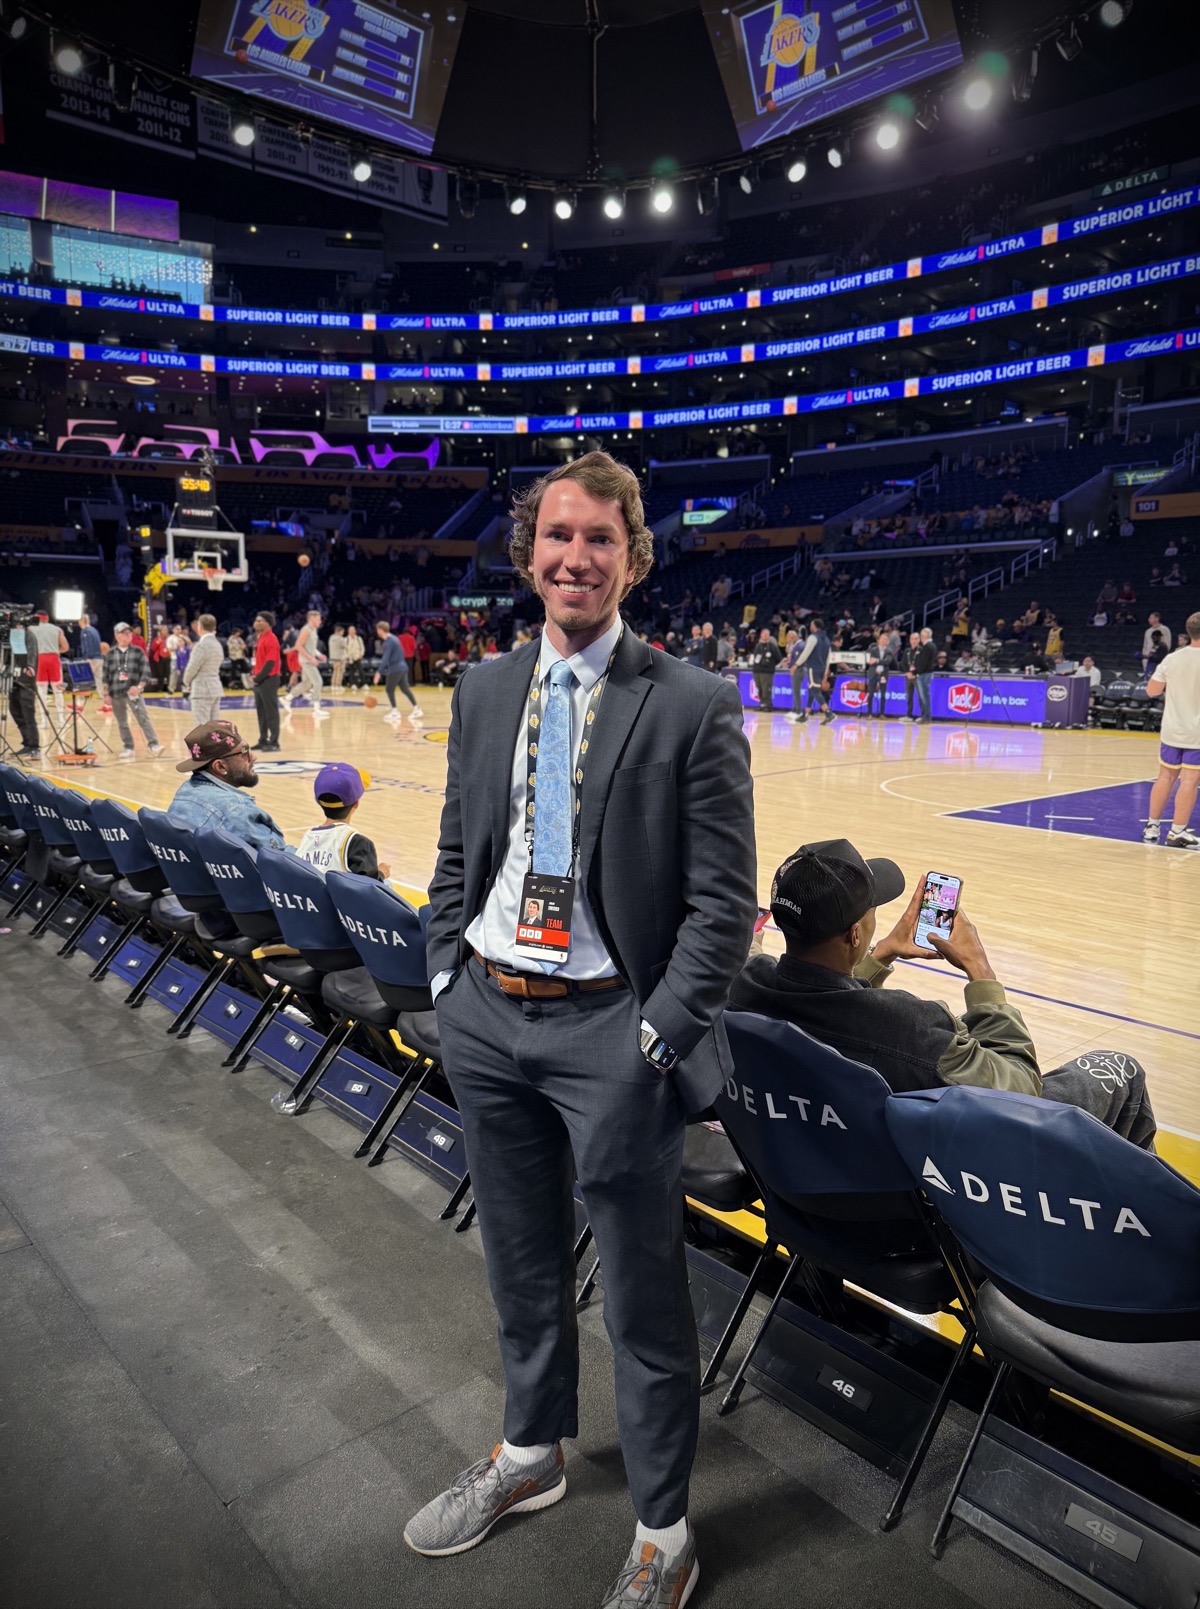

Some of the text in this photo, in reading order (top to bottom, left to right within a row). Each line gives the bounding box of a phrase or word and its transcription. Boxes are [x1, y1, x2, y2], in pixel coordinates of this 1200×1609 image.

[767, 25, 813, 59] LAKERS
[246, 43, 260, 58] LOS
[259, 48, 288, 68] ANGELES
[286, 58, 311, 77] LAKERS
[49, 73, 113, 104] CHAMPION
[771, 87, 784, 102] LOS
[60, 93, 111, 122] 2013-14
[136, 88, 168, 105] ANLEY
[170, 98, 190, 114] CUP
[134, 100, 192, 128] HAMPIONS
[136, 117, 183, 143] 2011-12
[267, 148, 296, 165] 2011-12
[313, 150, 348, 168] CHAMPION
[317, 163, 348, 181] 1992-93
[1115, 171, 1158, 192] DELTA
[1073, 204, 1144, 234] SUPERIOR
[1149, 191, 1193, 215] LIGHT
[985, 236, 1026, 257] ULTRA
[772, 267, 894, 302] SUPERIOR LIGHT BEER
[1062, 272, 1132, 300] SUPERIOR
[1136, 261, 1181, 283] LIGHT
[18, 286, 51, 300] BEER
[147, 301, 185, 315] ULTRA
[699, 297, 734, 312] ULTRA
[976, 299, 1016, 319] ULTRA
[226, 309, 350, 327] SUPERIOR LIGHT BEER
[431, 317, 467, 328] ULTRA
[504, 310, 620, 328] SUPERIOR LIGHT BEER
[30, 340, 55, 354] EER
[766, 325, 886, 357] SUPERIOR LIGHT BEER
[148, 353, 187, 366] ULTRA
[694, 351, 728, 365] ULTRA
[227, 359, 350, 376] SUPERIOR LIGHT BEER
[430, 367, 465, 378] ULTRA
[501, 361, 616, 378] SUPERIOR LIGHT BEER
[931, 354, 1072, 391] SUPERIOR LIGHT BEER
[853, 386, 890, 402] ULTRA
[581, 416, 616, 428] ULTRA
[653, 402, 771, 425] SUPERIOR LIGHT BEER
[1138, 502, 1156, 512] 101
[950, 686, 980, 710] Jack
[983, 694, 1026, 706] in the box
[6, 791, 31, 804] ELTA
[303, 851, 333, 867] AMES
[205, 861, 244, 879] DELTA
[267, 887, 320, 913] DELTA
[345, 914, 408, 948] DELTA
[546, 918, 563, 930] TEAM
[288, 1034, 299, 1046] 51
[726, 1077, 848, 1130] DELTA
[433, 1133, 446, 1146] 49
[960, 1171, 1152, 1238] DELTA
[832, 1377, 855, 1399] 46
[1082, 1519, 1119, 1545] 45
